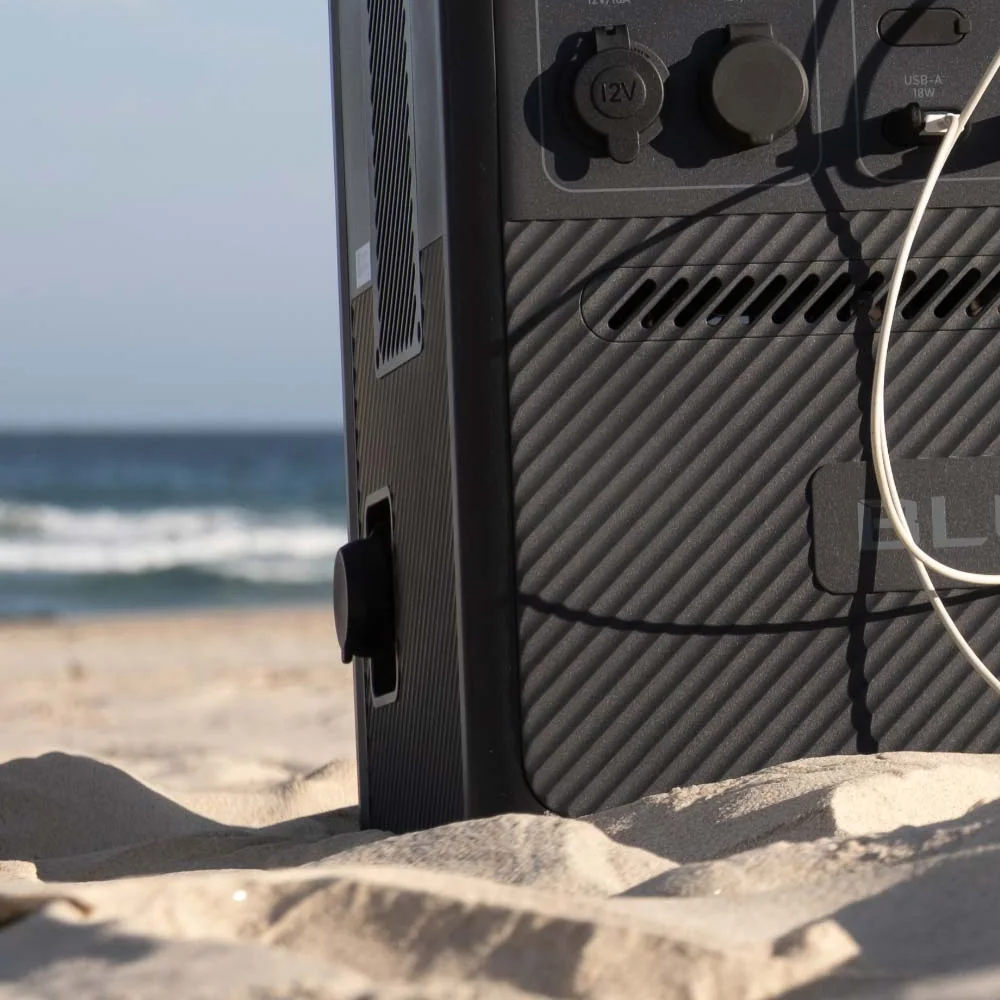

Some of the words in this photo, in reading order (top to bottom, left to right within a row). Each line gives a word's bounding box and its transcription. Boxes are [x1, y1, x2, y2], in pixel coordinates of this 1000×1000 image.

[904, 74, 942, 86] USB-A
[601, 81, 637, 103] 12V
[912, 86, 935, 98] 18W
